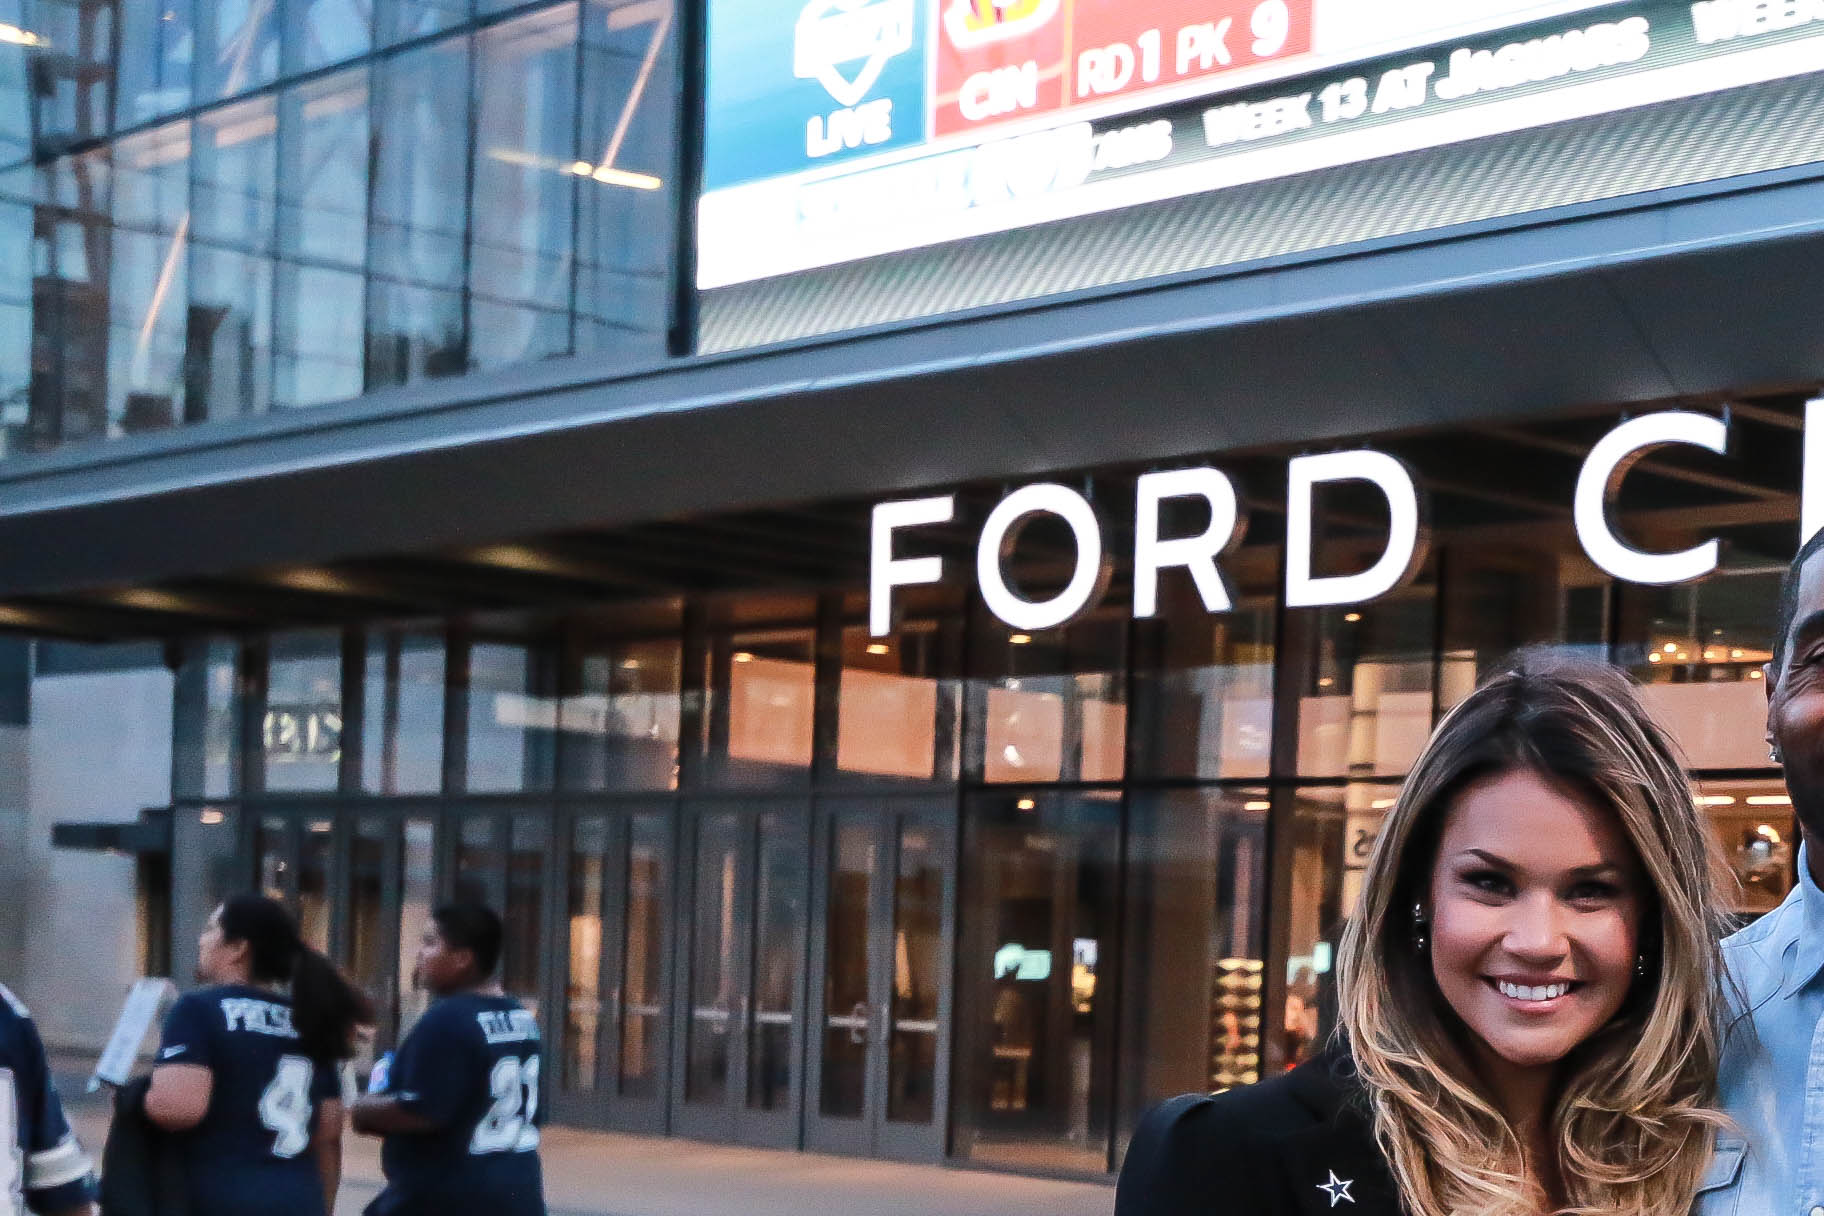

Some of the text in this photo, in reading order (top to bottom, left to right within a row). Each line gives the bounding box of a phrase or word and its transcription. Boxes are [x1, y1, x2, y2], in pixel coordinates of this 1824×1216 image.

[1176, 18, 1233, 76] PK
[1250, 0, 1291, 57] 9
[806, 98, 893, 158] LIVE
[959, 61, 1037, 120] CIN
[1316, 76, 1370, 123] 13
[1371, 61, 1435, 115] AT
[869, 449, 1420, 637] FORD
[258, 1054, 313, 1159] 4
[469, 1054, 541, 1156] 21
